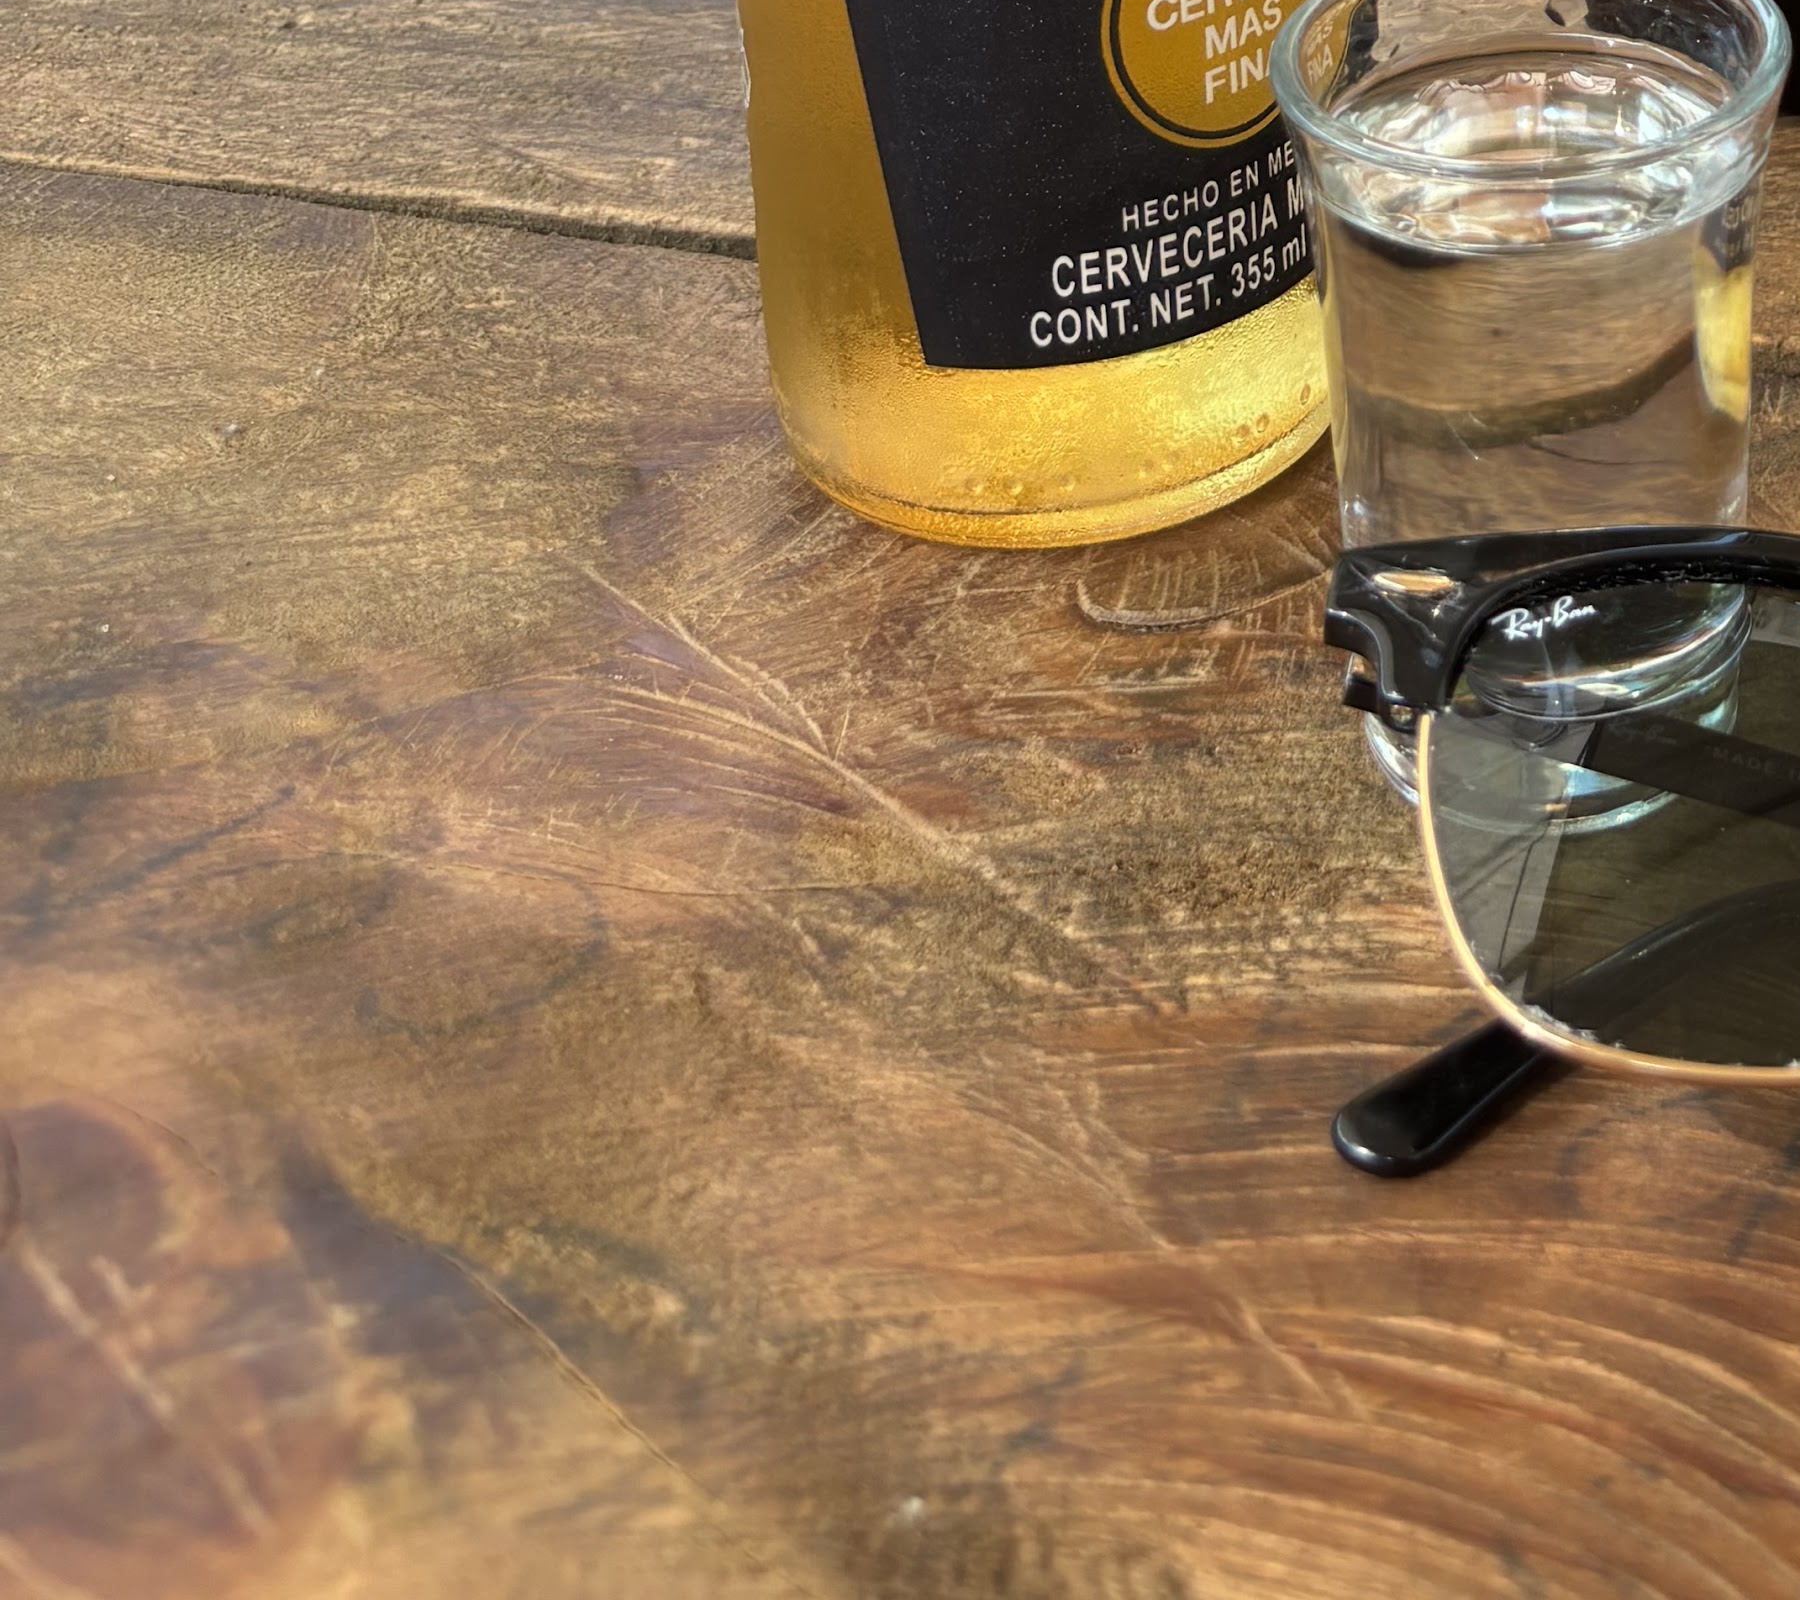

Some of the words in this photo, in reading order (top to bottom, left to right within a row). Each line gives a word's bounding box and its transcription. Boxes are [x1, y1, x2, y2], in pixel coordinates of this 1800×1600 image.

[1204, 40, 1275, 104] FIN
[1121, 179, 1220, 233] HECHO
[1230, 160, 1260, 198] EN
[1267, 140, 1295, 179] ME
[1051, 192, 1279, 299] CERVECERIA
[1286, 172, 1304, 221] M
[1029, 299, 1139, 348] CONT.
[1149, 273, 1223, 328] NET.
[1230, 245, 1276, 298] 355
[1281, 222, 1308, 272] ml
[1490, 595, 1597, 641] Ray-Ban
